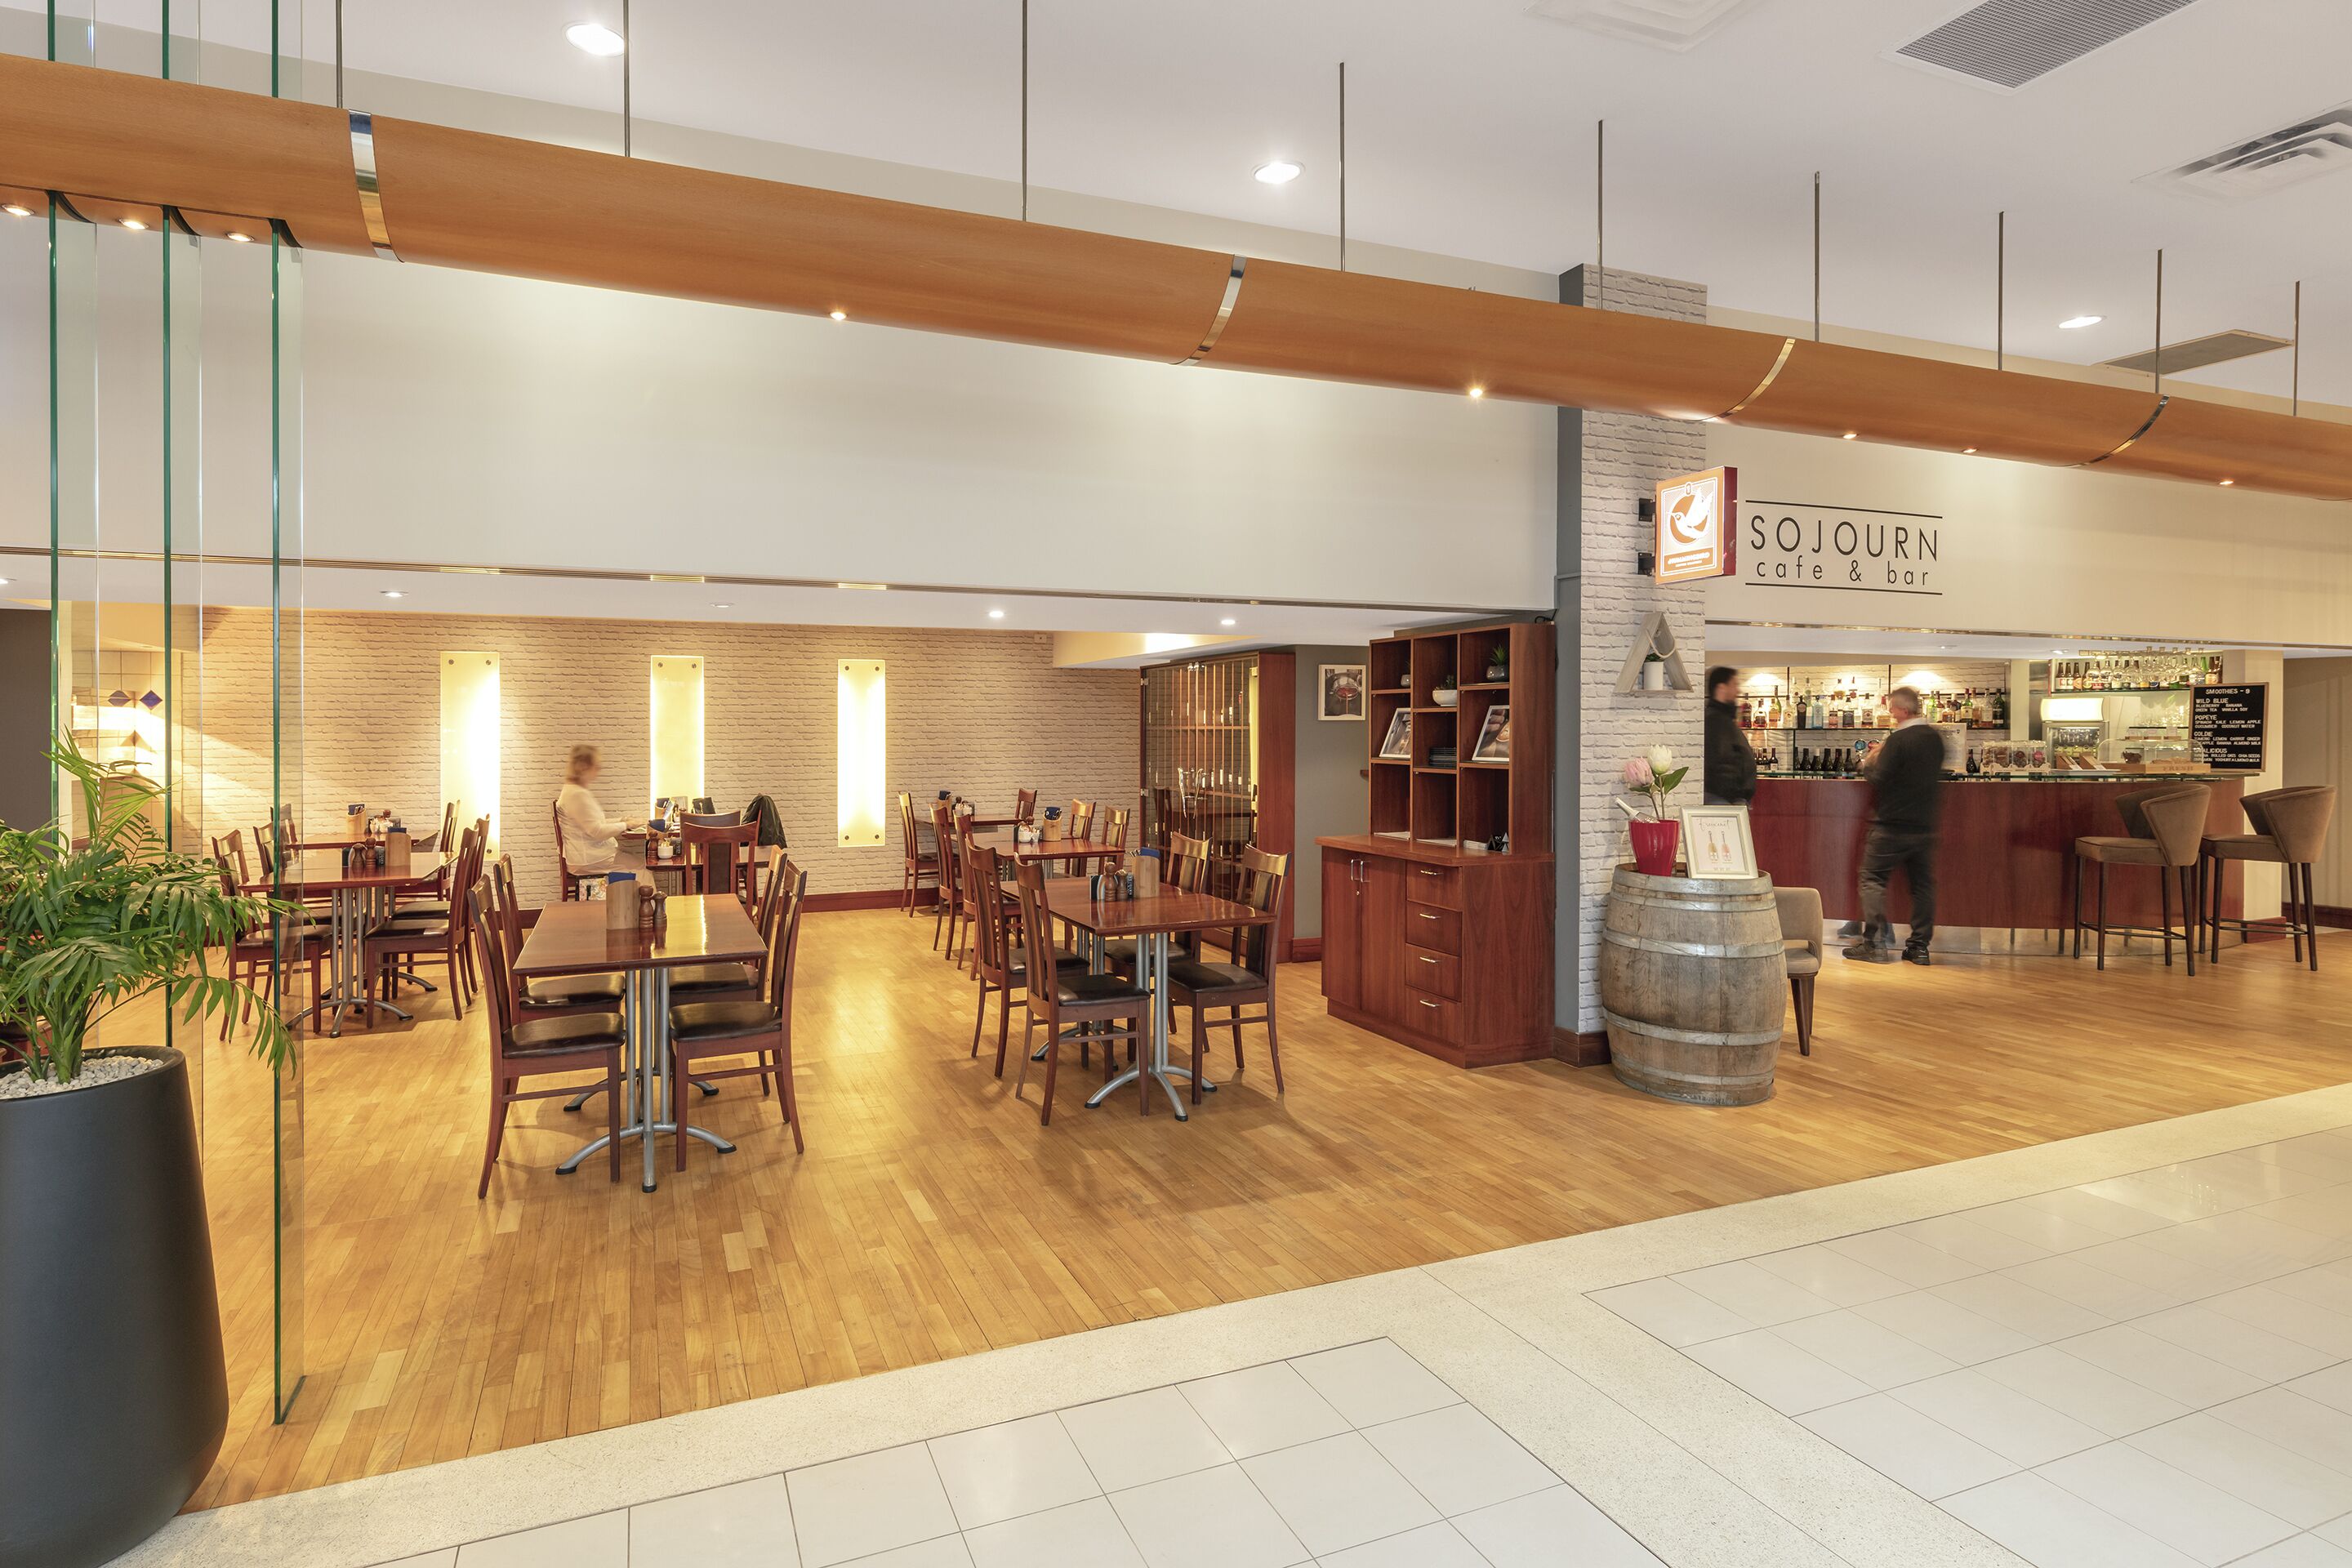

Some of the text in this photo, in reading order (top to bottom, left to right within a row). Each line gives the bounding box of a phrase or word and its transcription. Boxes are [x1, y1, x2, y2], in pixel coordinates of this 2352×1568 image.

[1751, 514, 1938, 562] SOJOURN
[1757, 555, 1928, 586] cafe & bar
